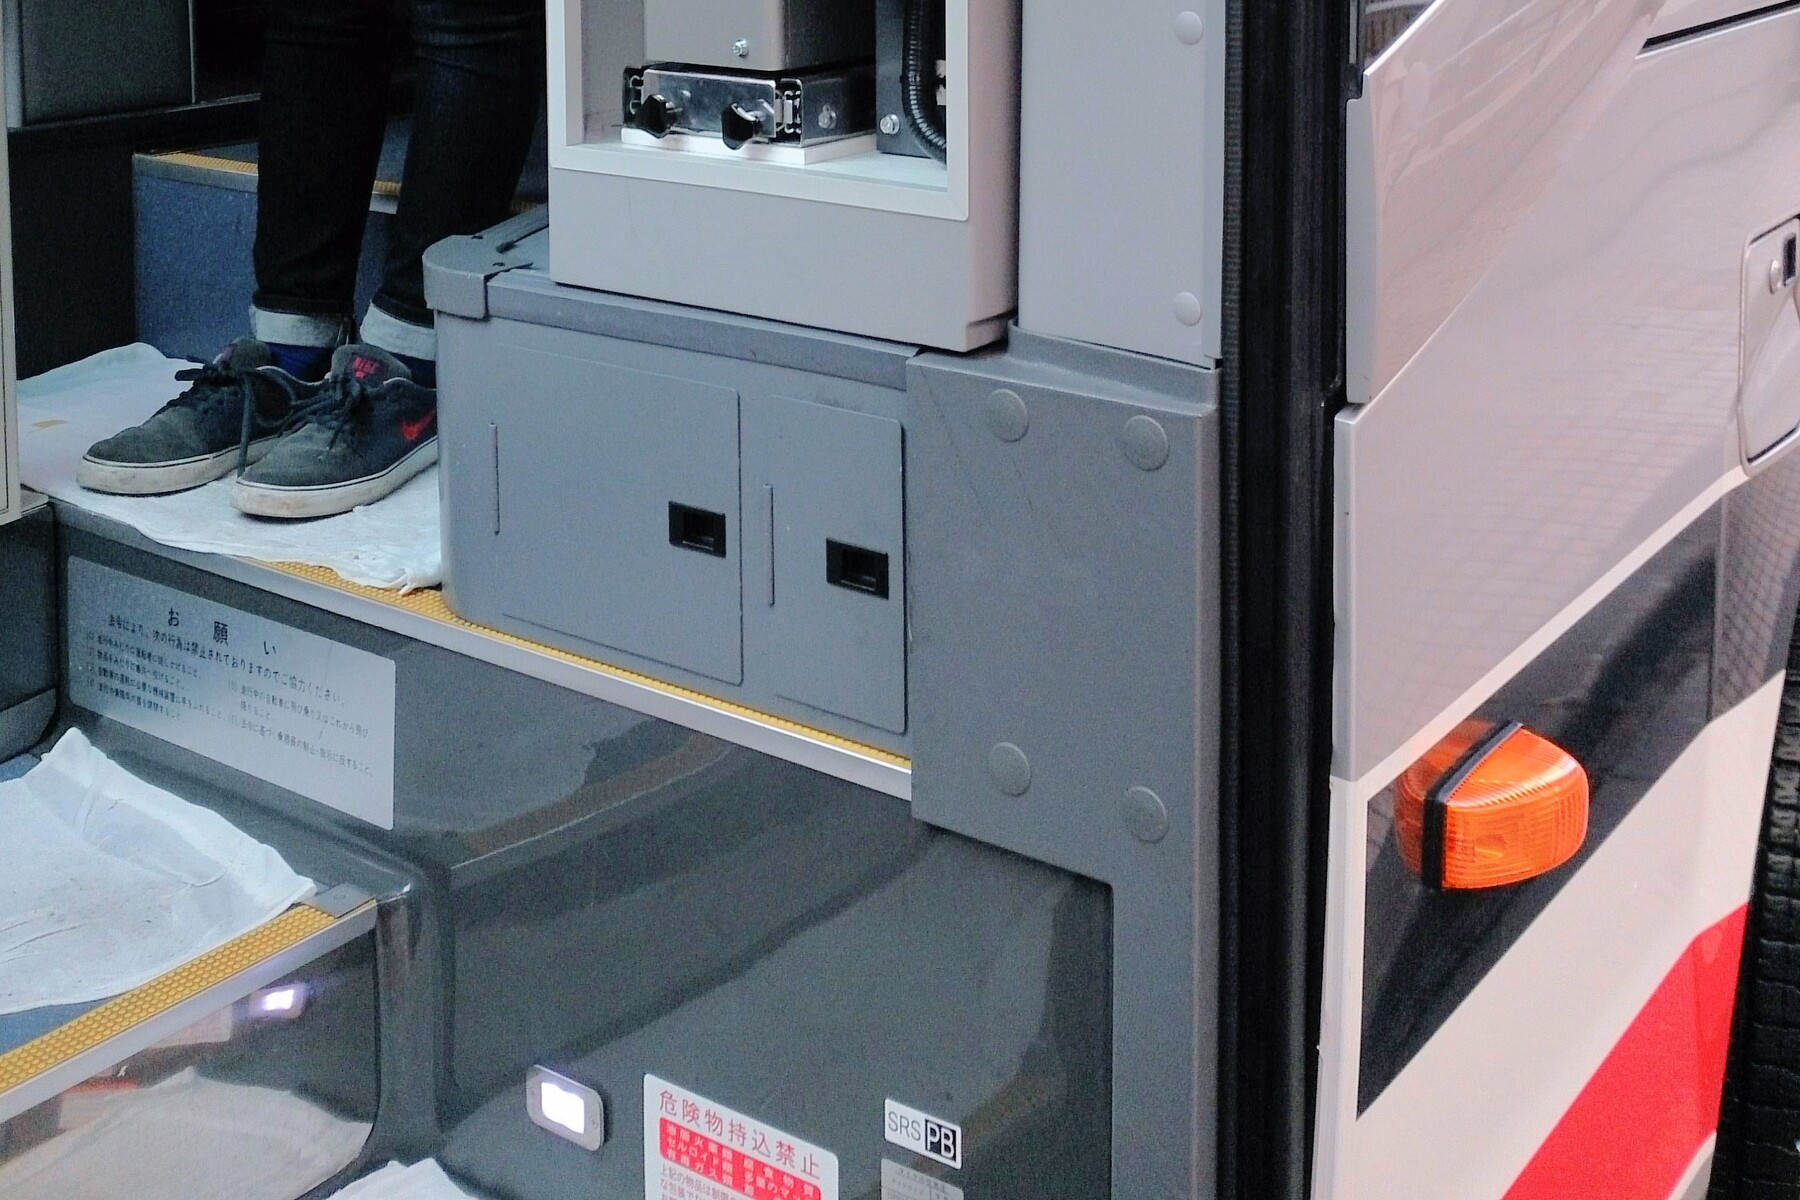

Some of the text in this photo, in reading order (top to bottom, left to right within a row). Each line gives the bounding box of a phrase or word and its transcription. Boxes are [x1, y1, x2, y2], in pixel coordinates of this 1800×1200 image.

[658, 1090, 821, 1180] 危険物持込禁止
[888, 1111, 955, 1159] SRS PB
